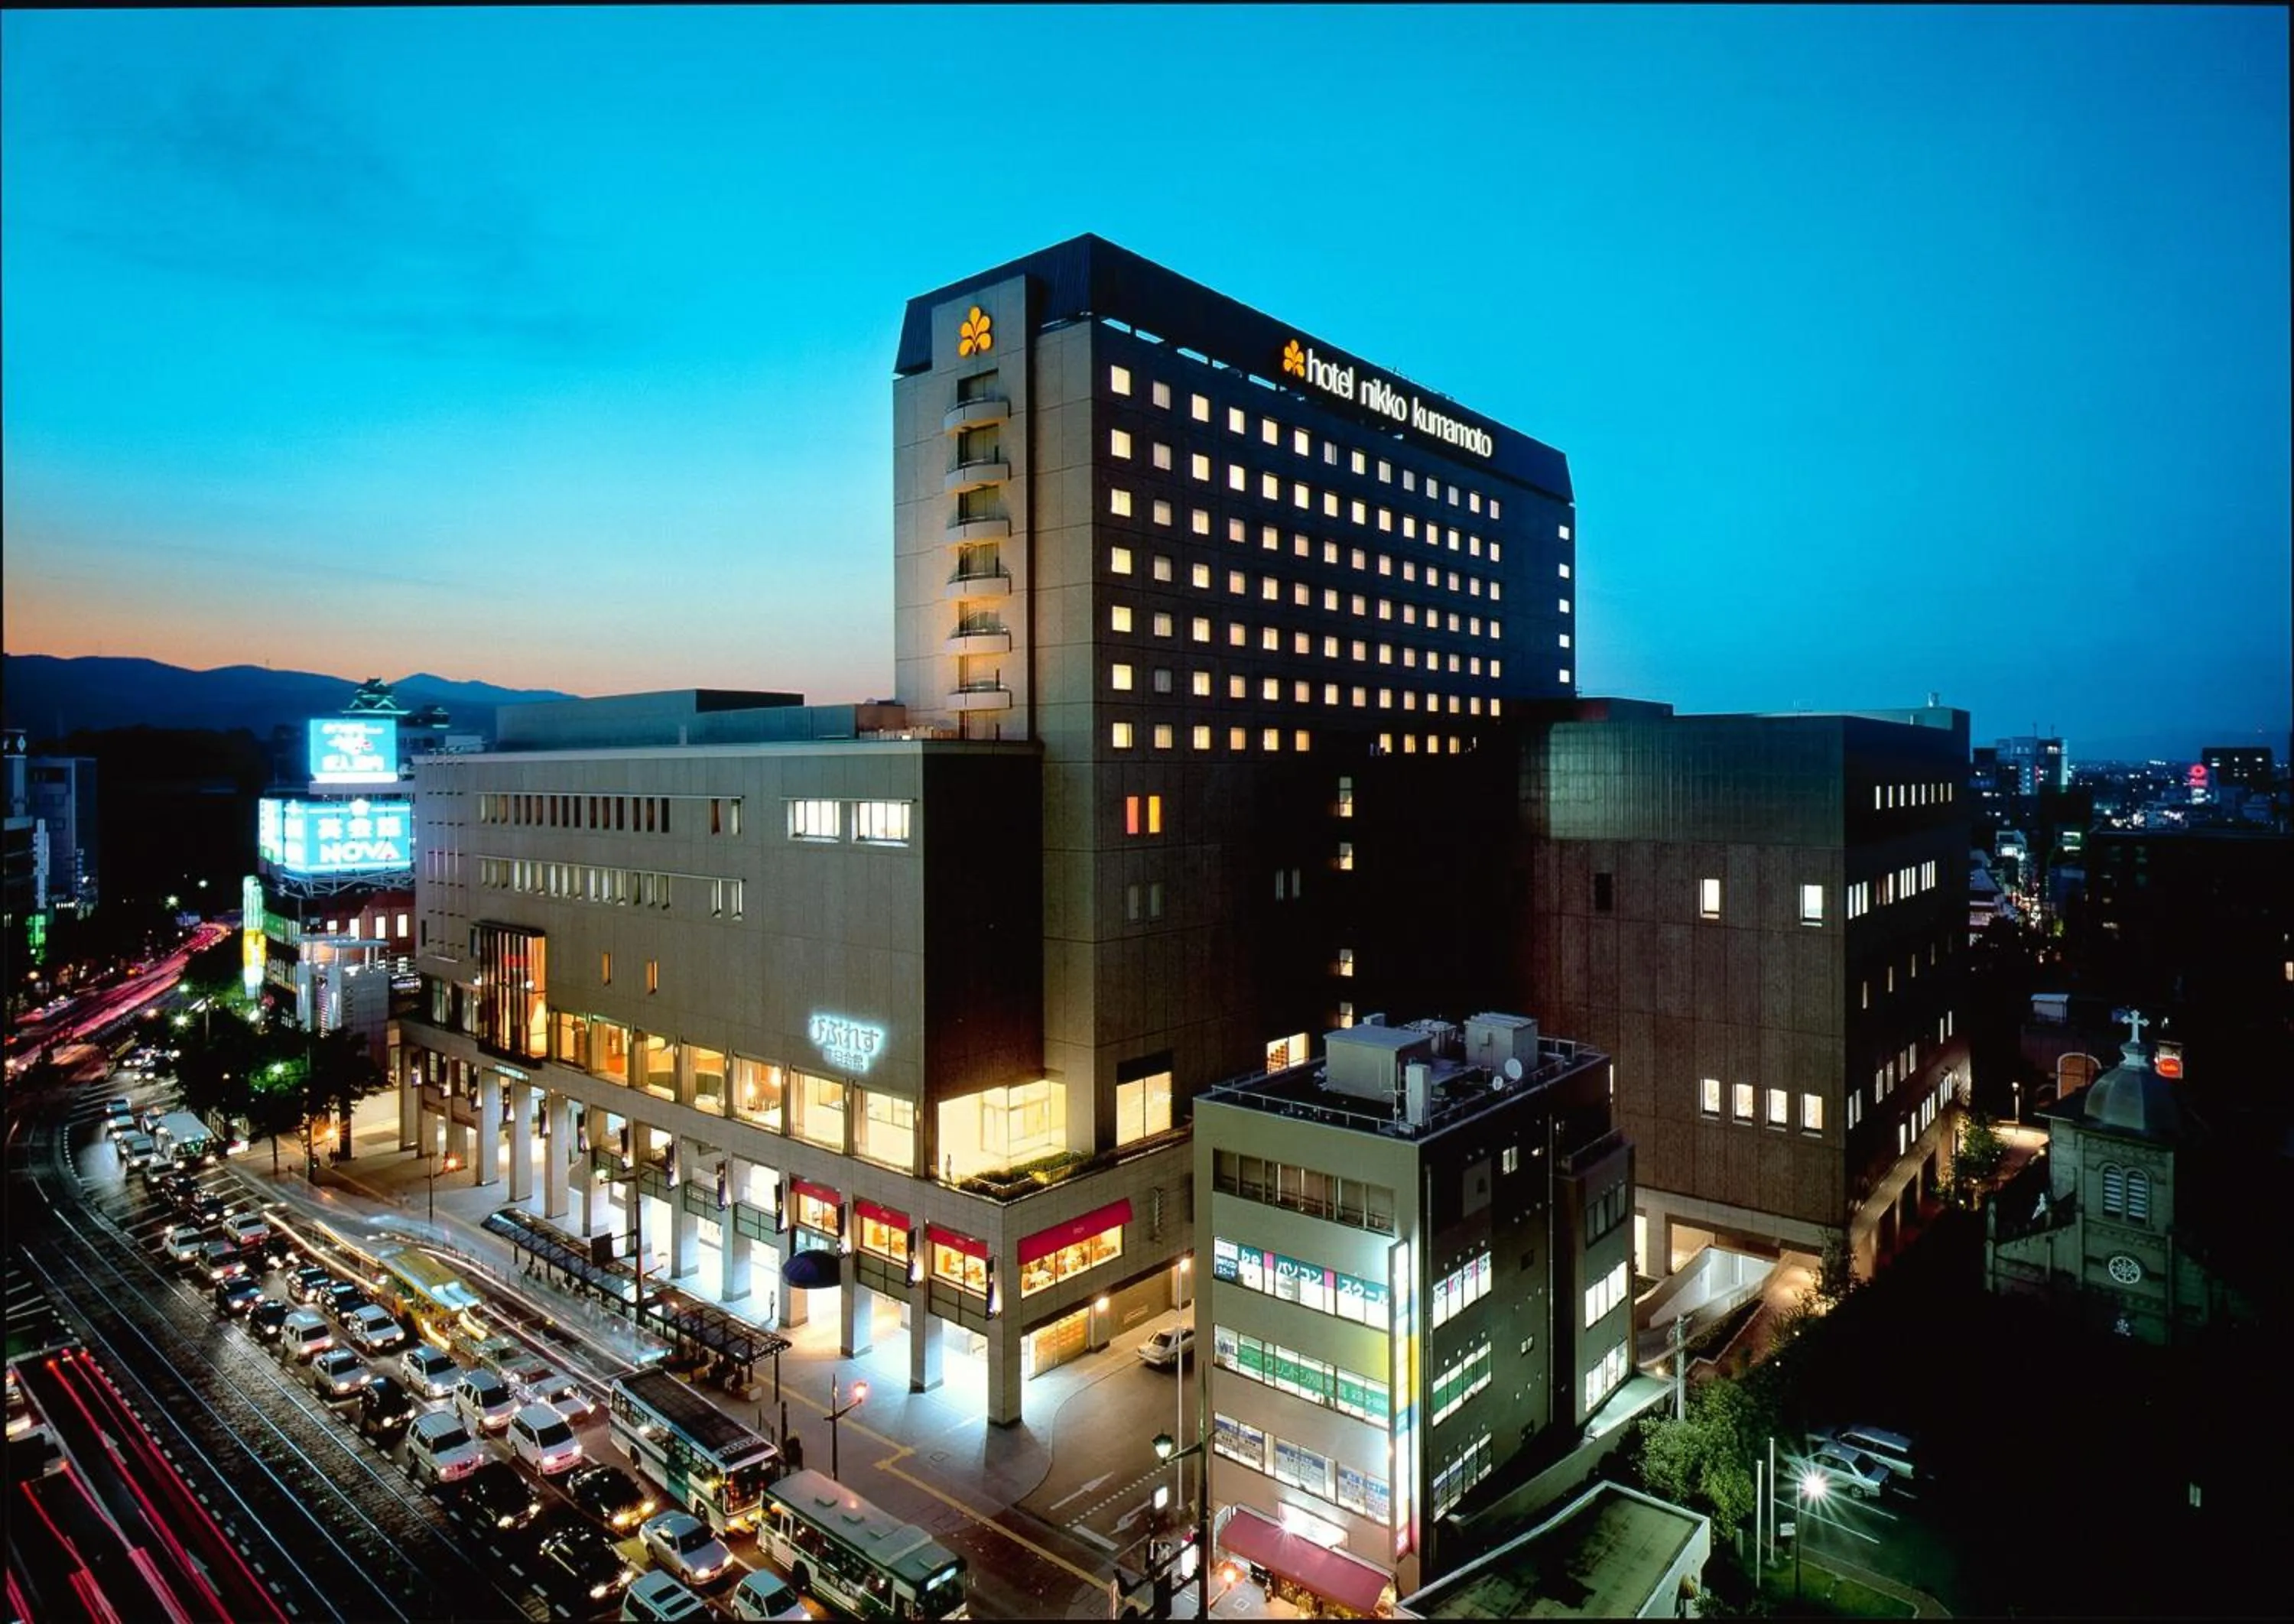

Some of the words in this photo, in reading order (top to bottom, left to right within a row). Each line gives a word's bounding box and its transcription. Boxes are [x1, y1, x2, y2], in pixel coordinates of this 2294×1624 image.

[1307, 347, 1353, 400] hotel
[1360, 378, 1408, 421] nikko
[1413, 396, 1492, 458] kumamoto
[319, 840, 401, 865] NOVA
[1241, 1249, 1261, 1266] be
[1276, 1261, 1324, 1286] パソコン
[1340, 1278, 1389, 1307] スクール
